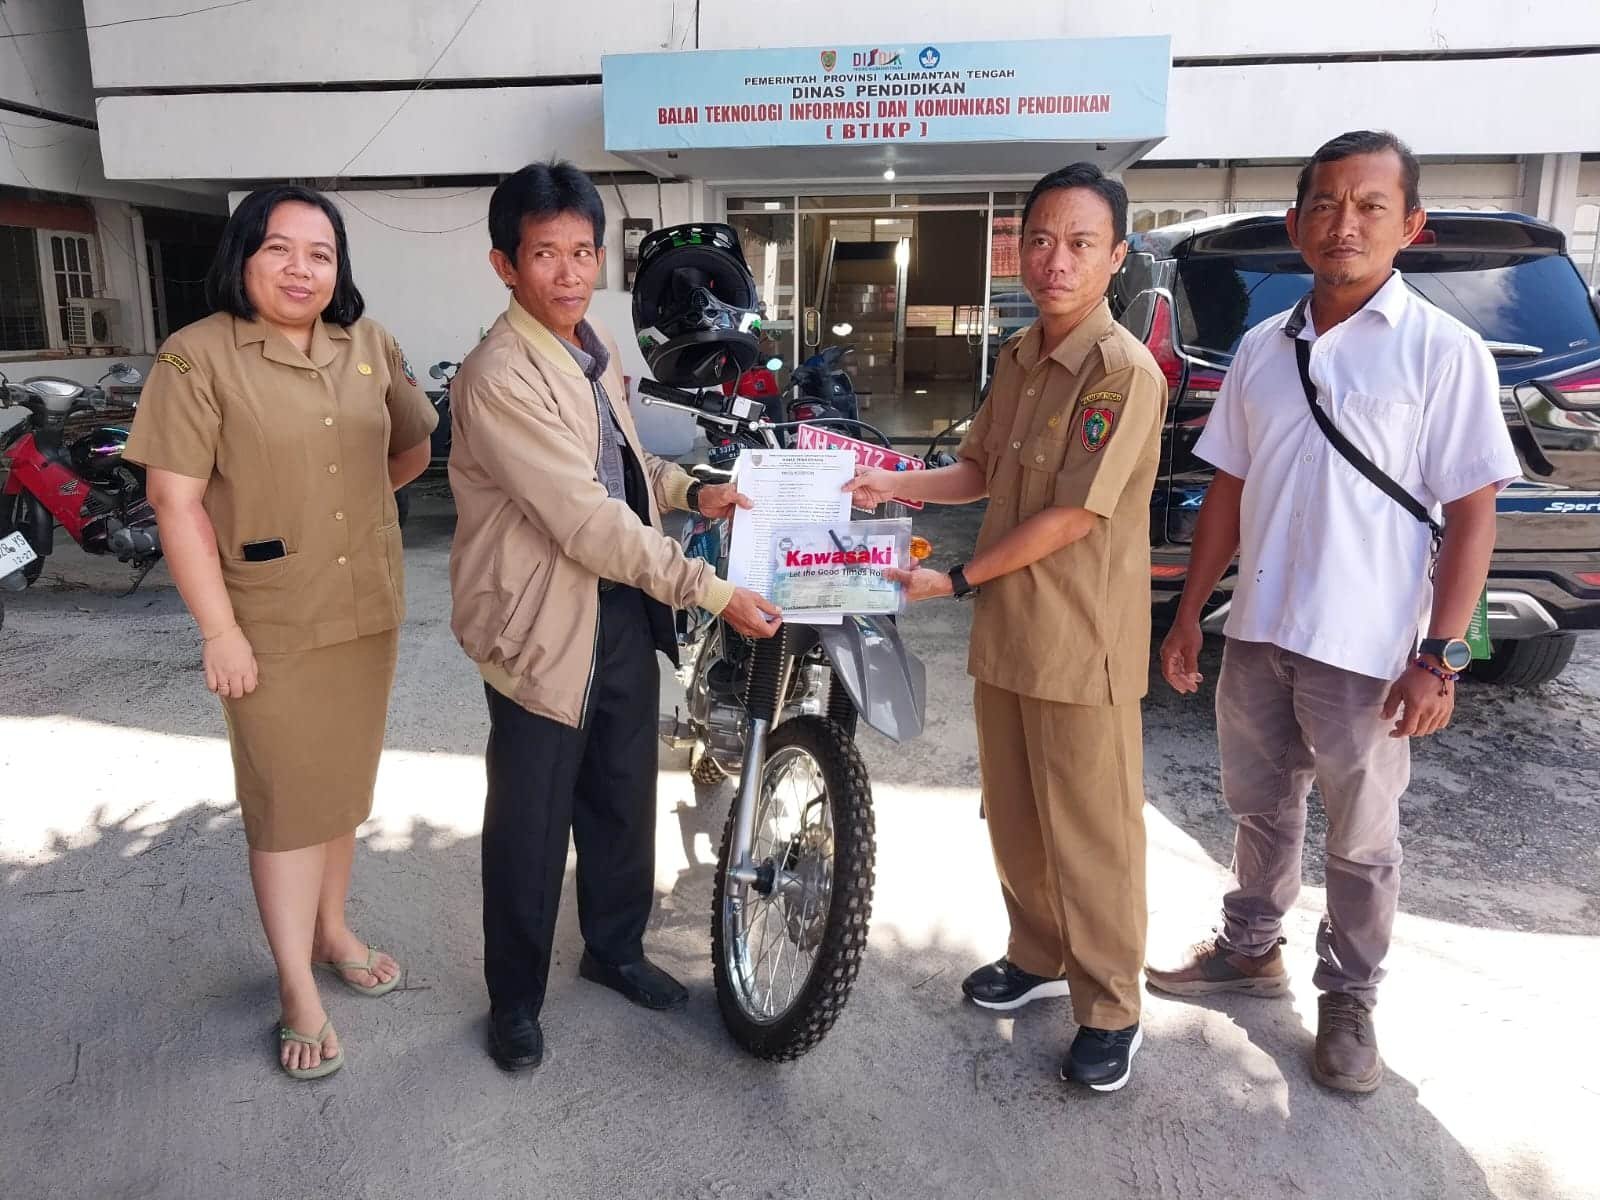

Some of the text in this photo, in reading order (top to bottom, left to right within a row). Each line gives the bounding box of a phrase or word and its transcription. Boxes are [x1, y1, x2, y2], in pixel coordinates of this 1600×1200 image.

[744, 69, 1015, 86] PEMERINTAH PROVINSI KALIMANTAN TENGAH
[792, 82, 966, 99] DINAS PENDIDIKAN
[658, 94, 1111, 125] BALAI TEKNOLOGI INFORMASI DAN KOMUNIKASI PENDIDIKAN
[842, 122, 912, 140] BTIKP
[786, 546, 892, 567] Kawasaki
[789, 570, 801, 578] Let
[803, 568, 816, 577] the
[818, 568, 840, 577] Good
[842, 567, 867, 577] Times
